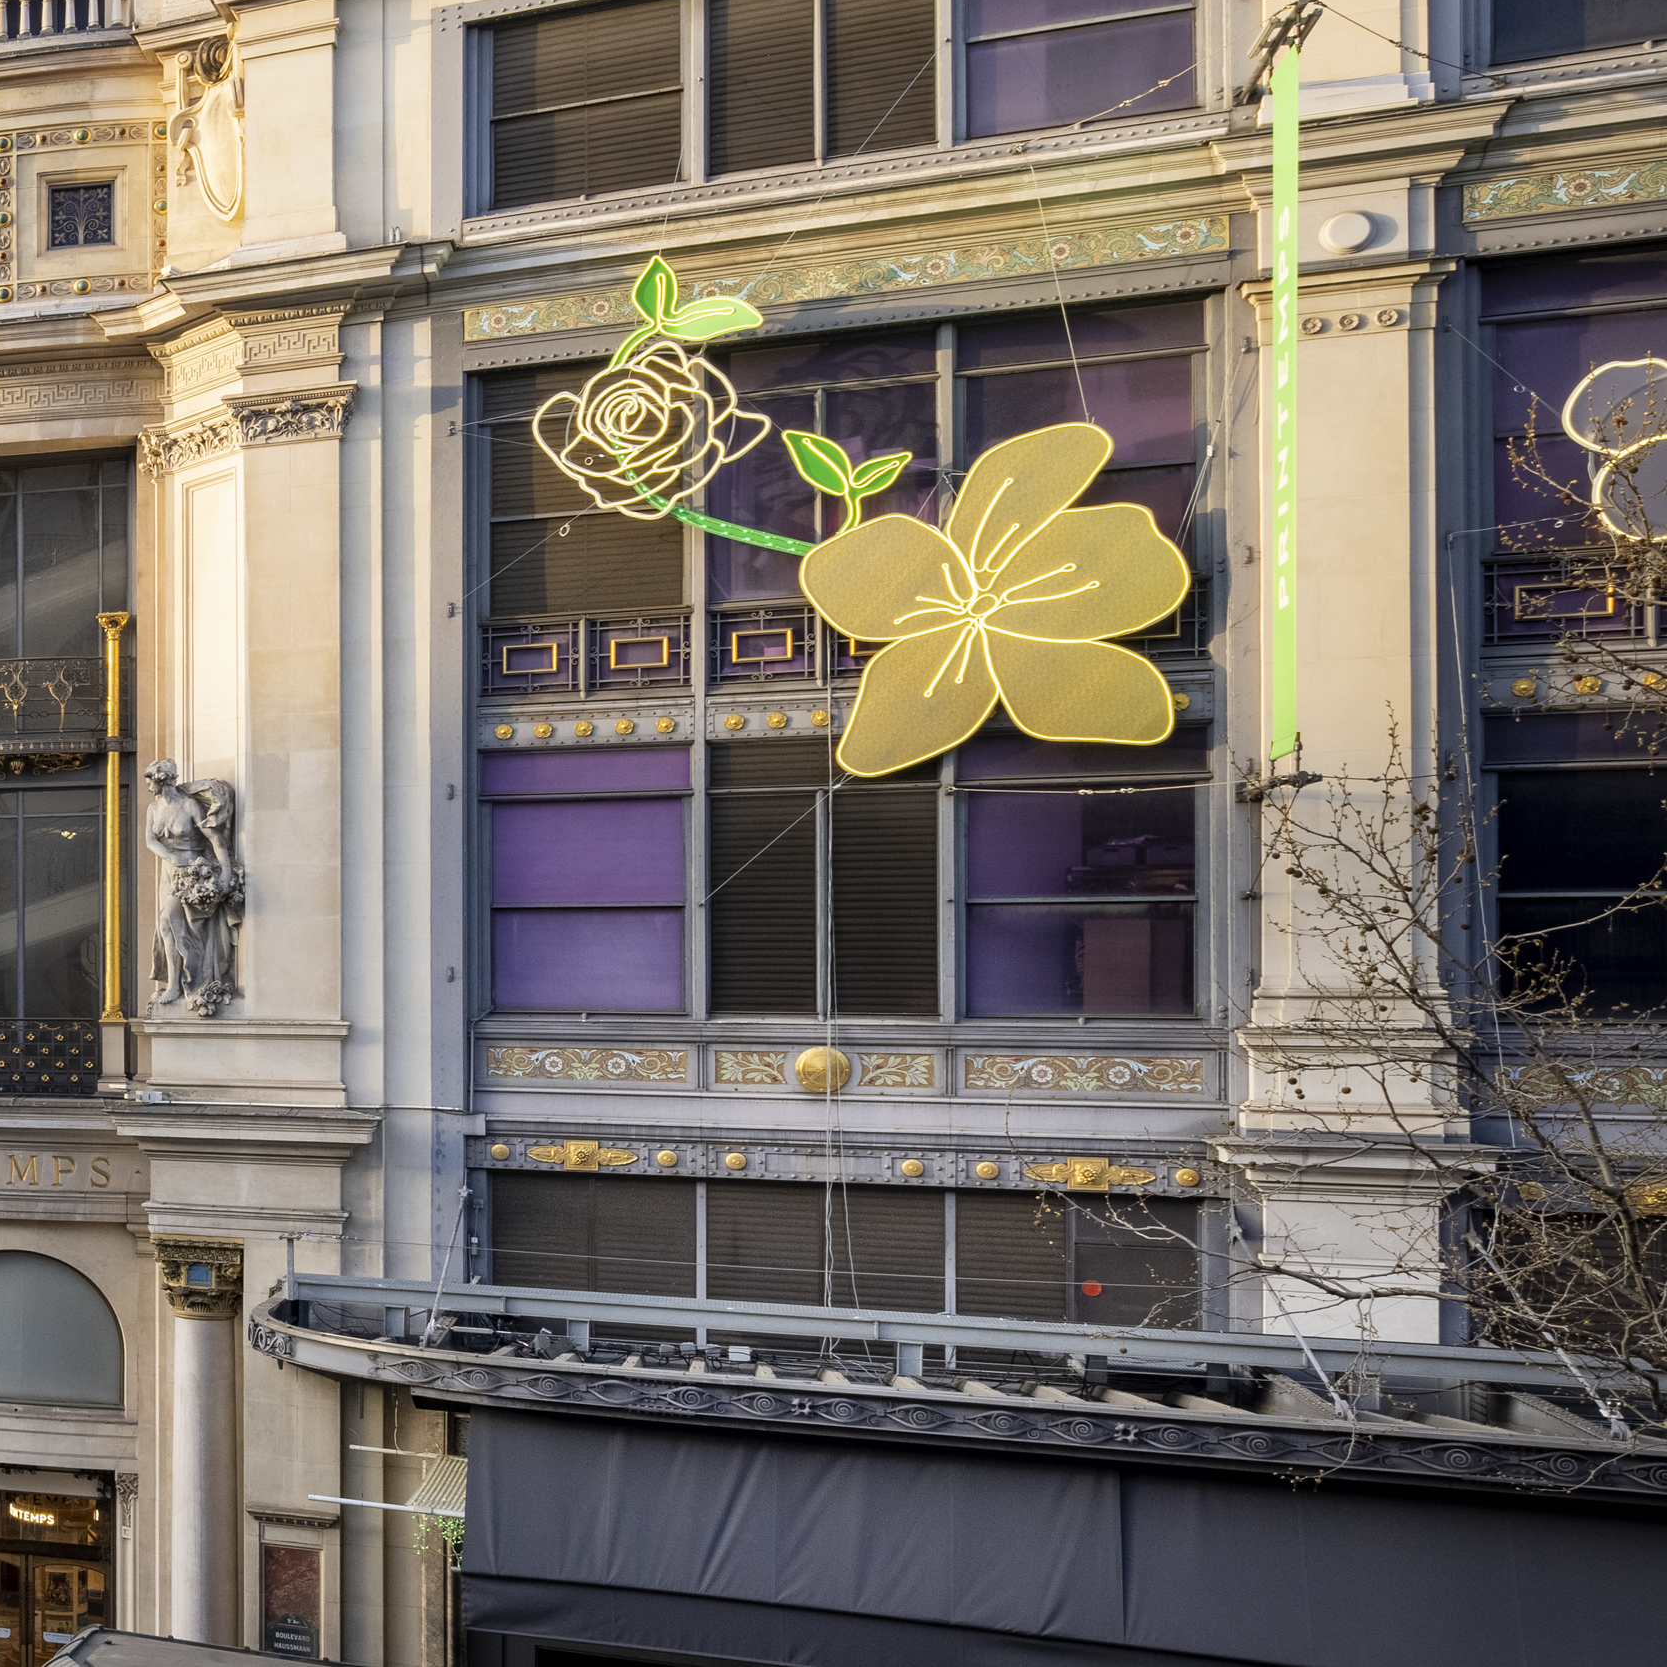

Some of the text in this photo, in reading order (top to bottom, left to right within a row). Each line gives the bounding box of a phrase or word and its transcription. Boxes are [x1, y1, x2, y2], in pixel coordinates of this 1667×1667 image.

[1276, 205, 1290, 611] PRINTEMPS
[275, 1632, 310, 1642] BOULEVARD
[274, 1642, 311, 1652] HAUSSMANN
